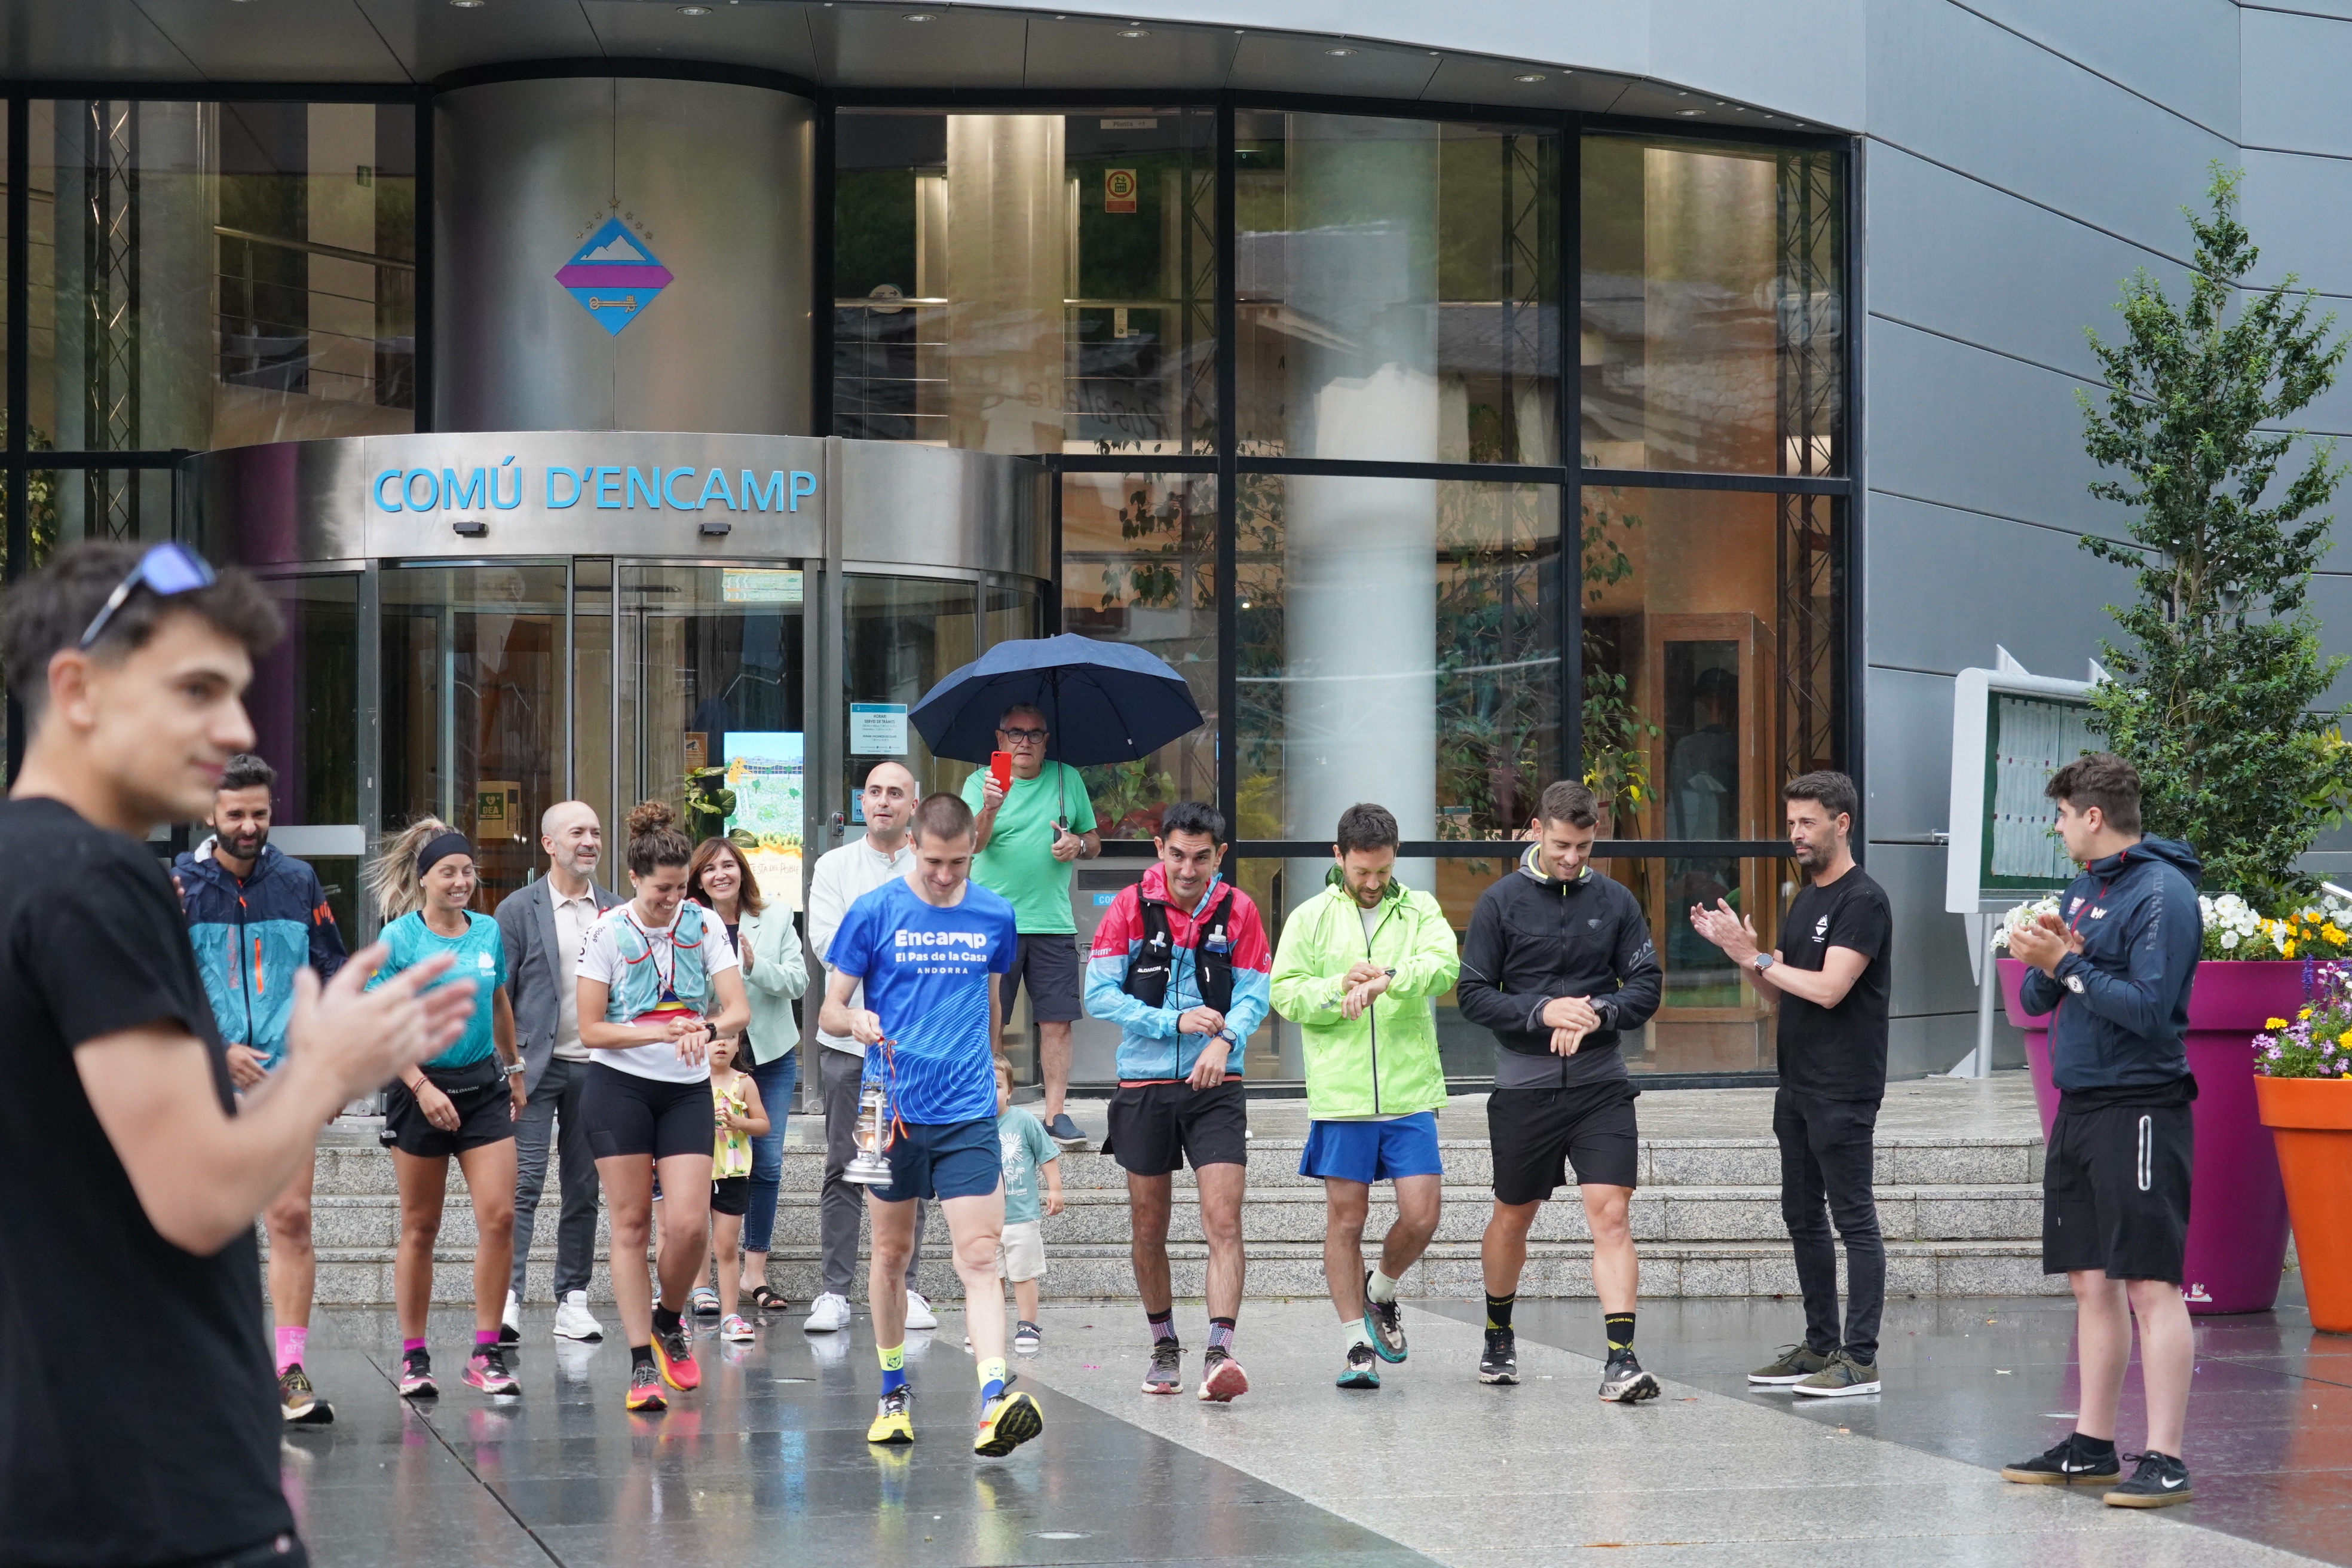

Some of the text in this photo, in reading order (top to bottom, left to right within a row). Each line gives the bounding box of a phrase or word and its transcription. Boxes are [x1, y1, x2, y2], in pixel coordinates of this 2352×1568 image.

[373, 455, 817, 513] COMÚ D'ENCAMP
[780, 862, 800, 875] POBLE
[895, 929, 987, 949] Encamp
[896, 951, 987, 963] El Pas de la Casa
[446, 1086, 479, 1094] SALOMON
